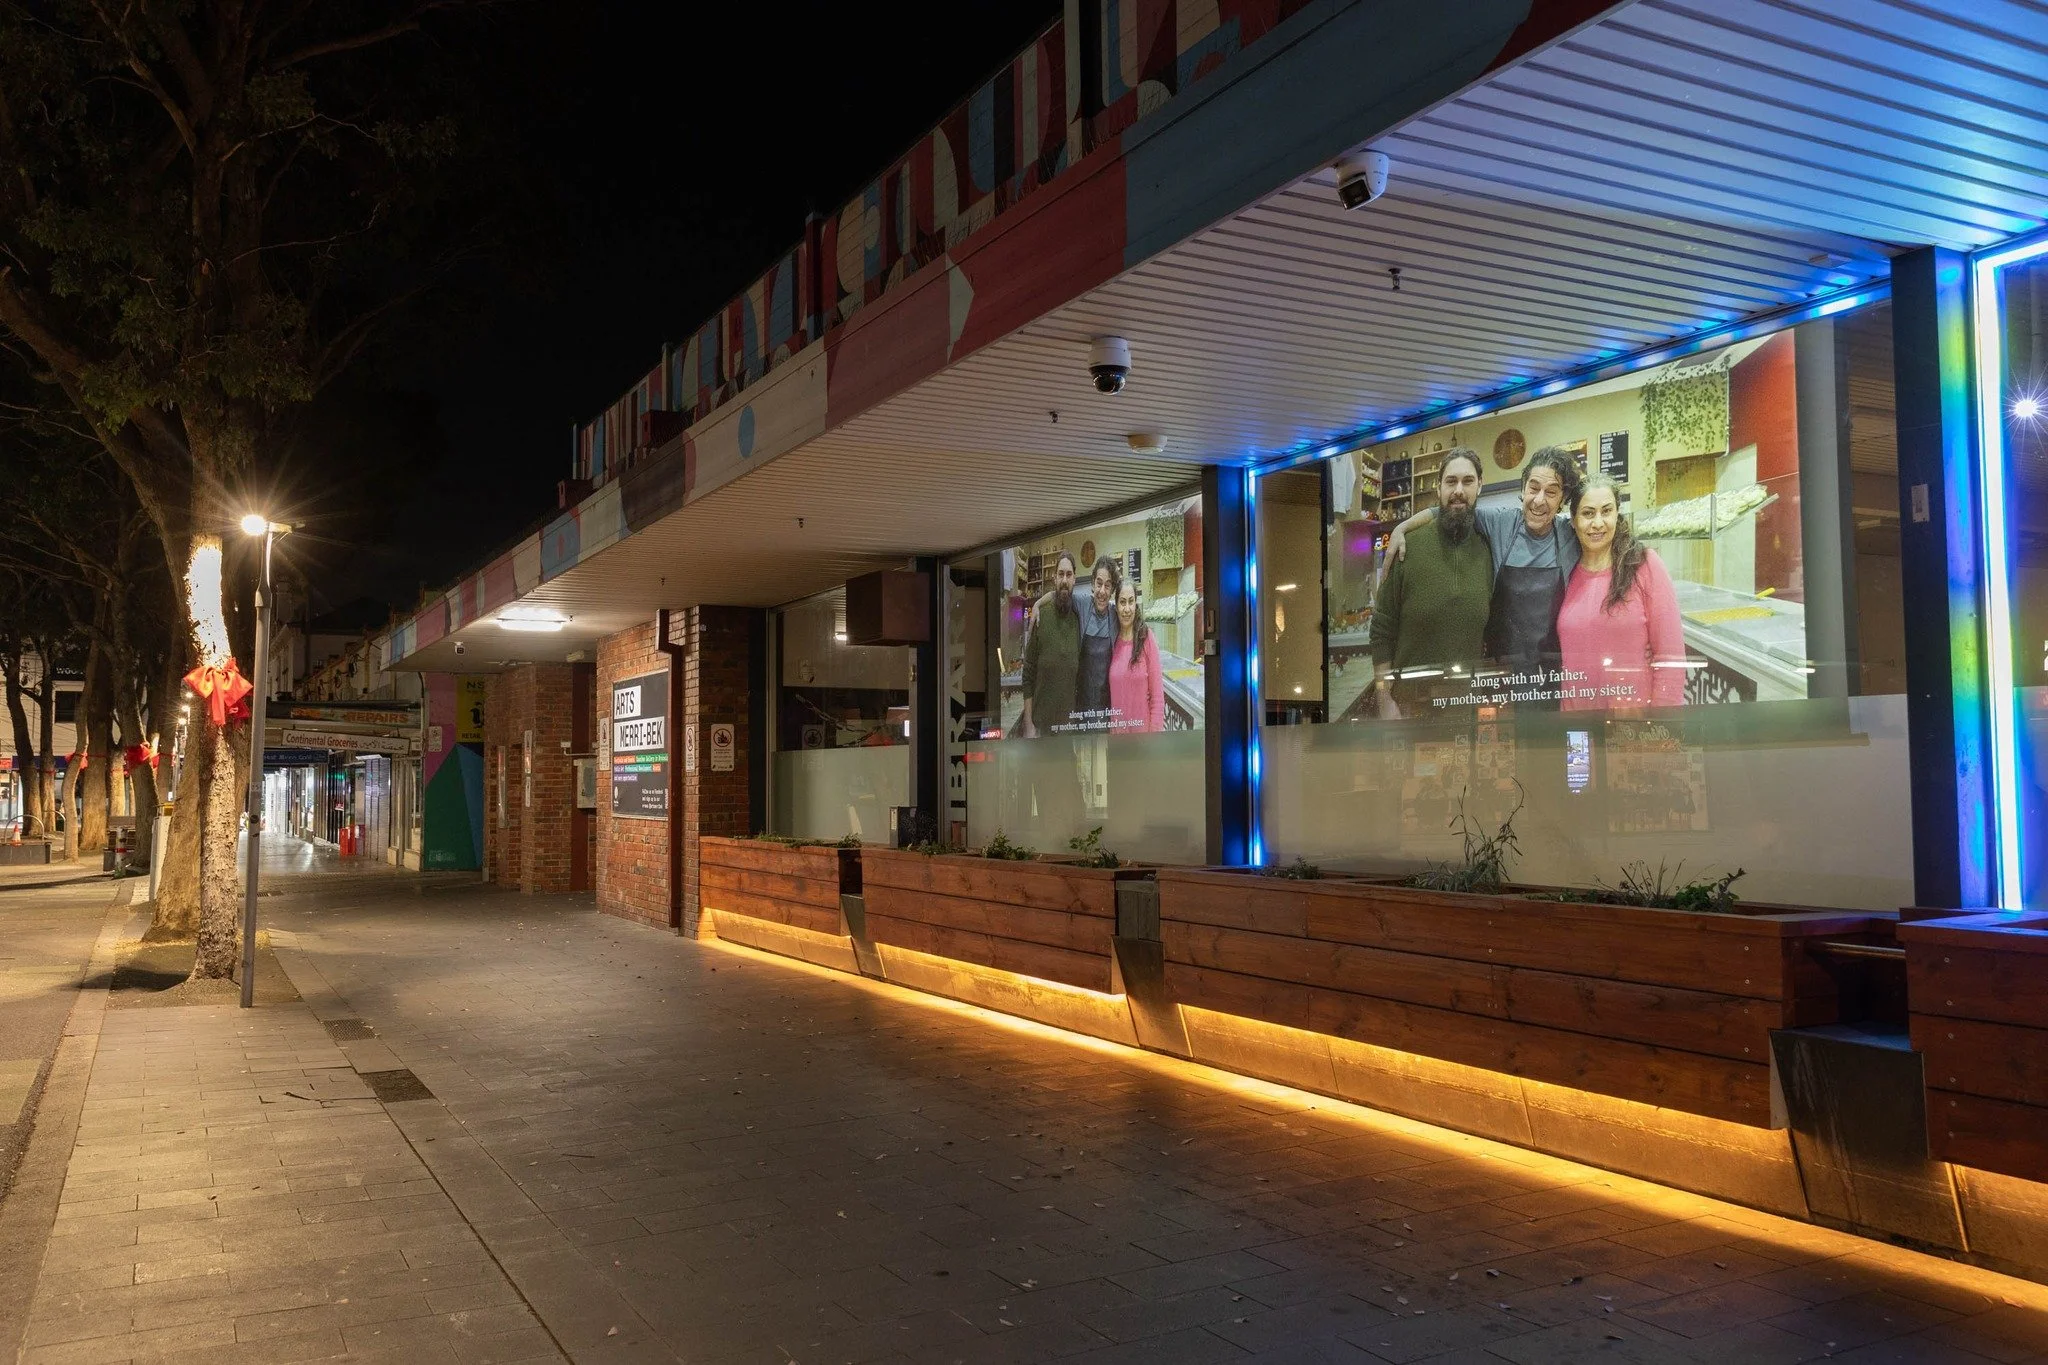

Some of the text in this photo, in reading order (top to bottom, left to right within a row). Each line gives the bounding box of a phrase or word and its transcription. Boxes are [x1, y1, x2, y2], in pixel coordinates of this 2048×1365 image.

[1471, 669, 1588, 689] along with my father,
[616, 691, 635, 715] ARTS
[1433, 684, 1637, 709] my mother, my brother and my sister.
[347, 711, 408, 724] REPAIRS
[1069, 711, 1083, 720] along
[1084, 708, 1095, 717] with
[1096, 709, 1105, 718] my
[620, 721, 662, 747] MERRI-BEK
[1051, 724, 1059, 733] my
[1079, 722, 1087, 731] my
[1088, 720, 1107, 729] brother
[1107, 719, 1118, 728] and
[1119, 720, 1127, 729] my
[286, 733, 358, 748] Continental Groceries
